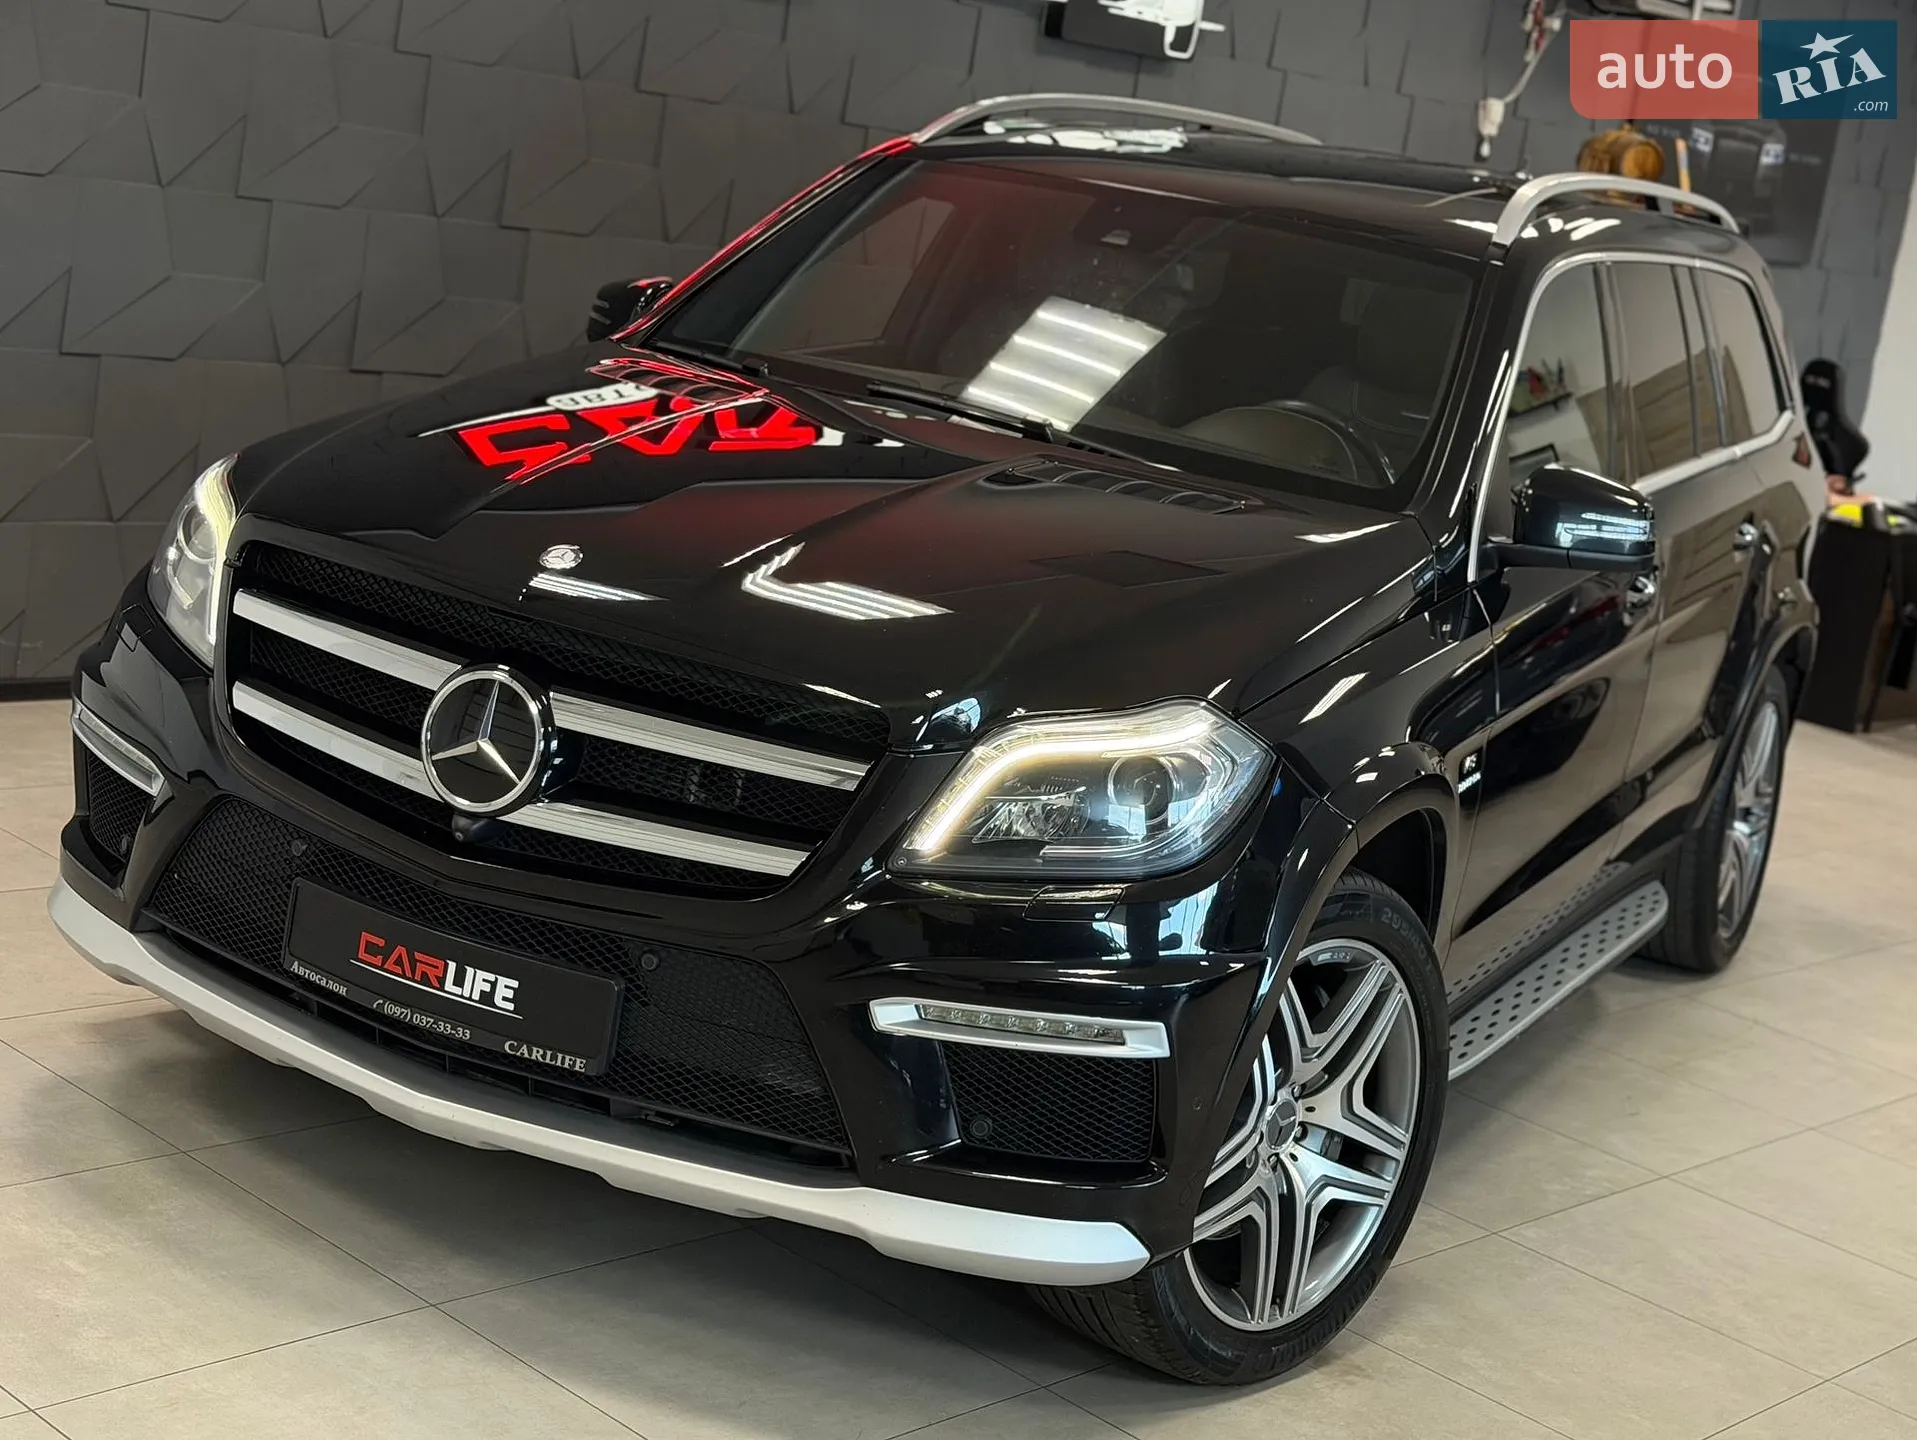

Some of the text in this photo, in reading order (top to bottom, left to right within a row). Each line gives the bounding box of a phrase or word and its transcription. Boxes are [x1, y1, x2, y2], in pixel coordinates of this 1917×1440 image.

[290, 960, 588, 1073] Автосалон (097) 037-33-33 CARLIFE
[357, 931, 520, 1011] CARLIFE
